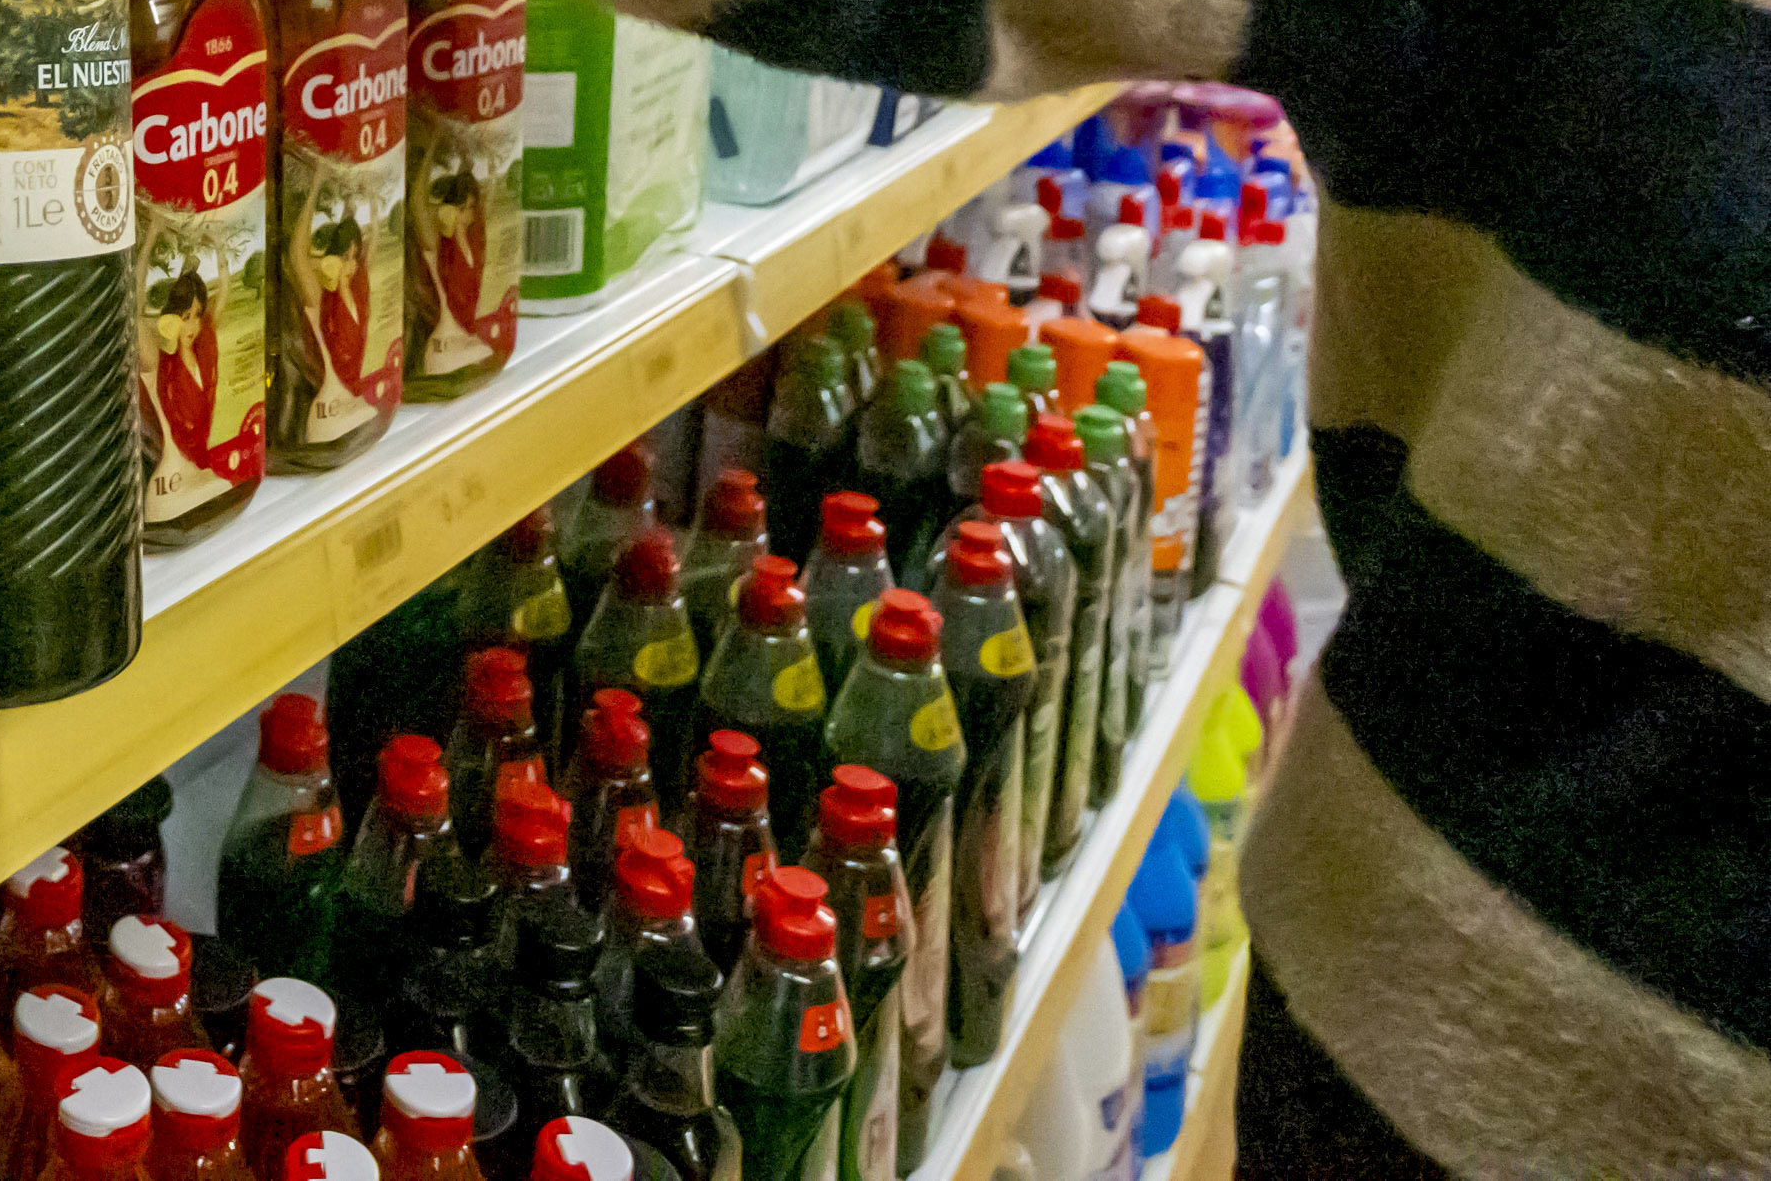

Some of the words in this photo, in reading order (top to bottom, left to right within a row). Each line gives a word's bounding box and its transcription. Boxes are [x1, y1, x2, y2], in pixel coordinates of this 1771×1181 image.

[61, 20, 116, 53] Blend
[205, 35, 233, 56] 1866
[422, 31, 526, 82] Carbone
[37, 63, 69, 90] EL
[301, 63, 407, 120] Carbone
[477, 83, 506, 119] 0,4
[133, 102, 267, 165] Carbone
[359, 118, 388, 157] 0,4
[13, 159, 56, 174] CONT
[15, 174, 58, 190] NETO
[202, 162, 240, 206] 0,4
